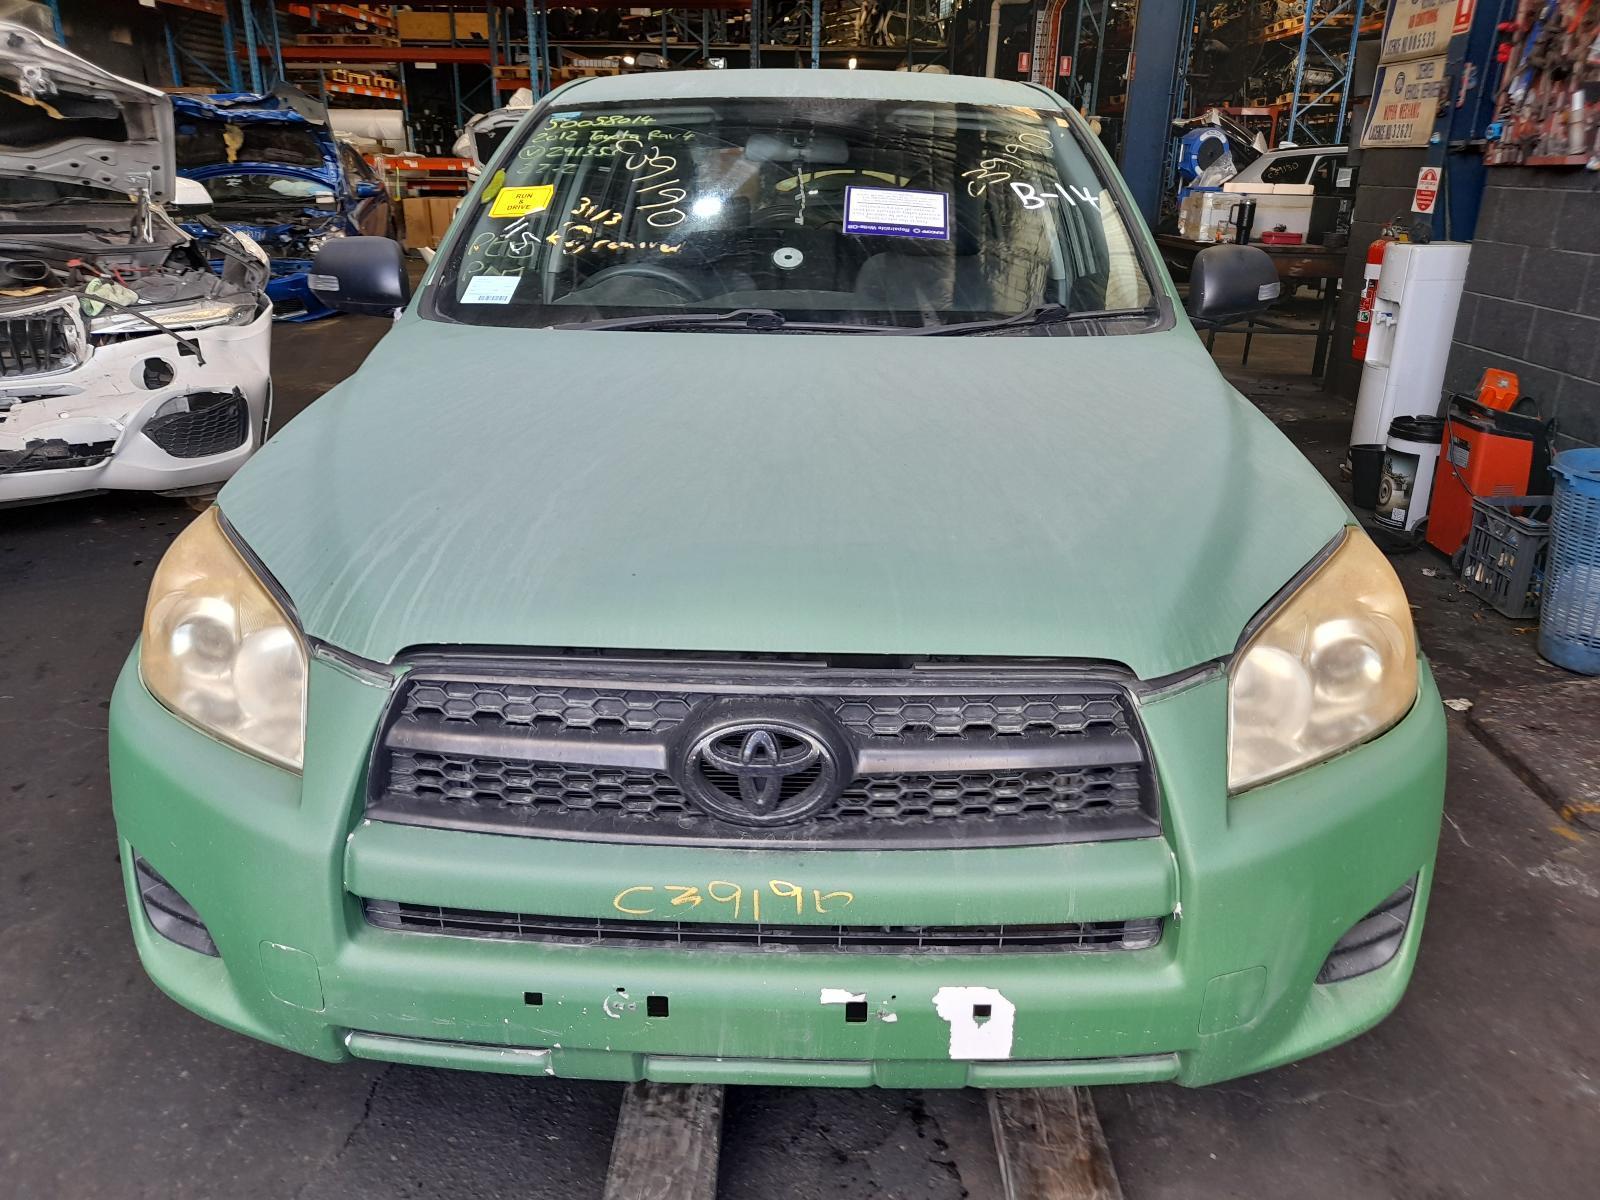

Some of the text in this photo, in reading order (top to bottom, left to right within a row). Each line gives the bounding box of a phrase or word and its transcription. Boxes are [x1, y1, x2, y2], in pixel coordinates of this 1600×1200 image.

[532, 130, 579, 143] 2012
[1010, 182, 1101, 210] B-14
[877, 225, 910, 233] Repairable
